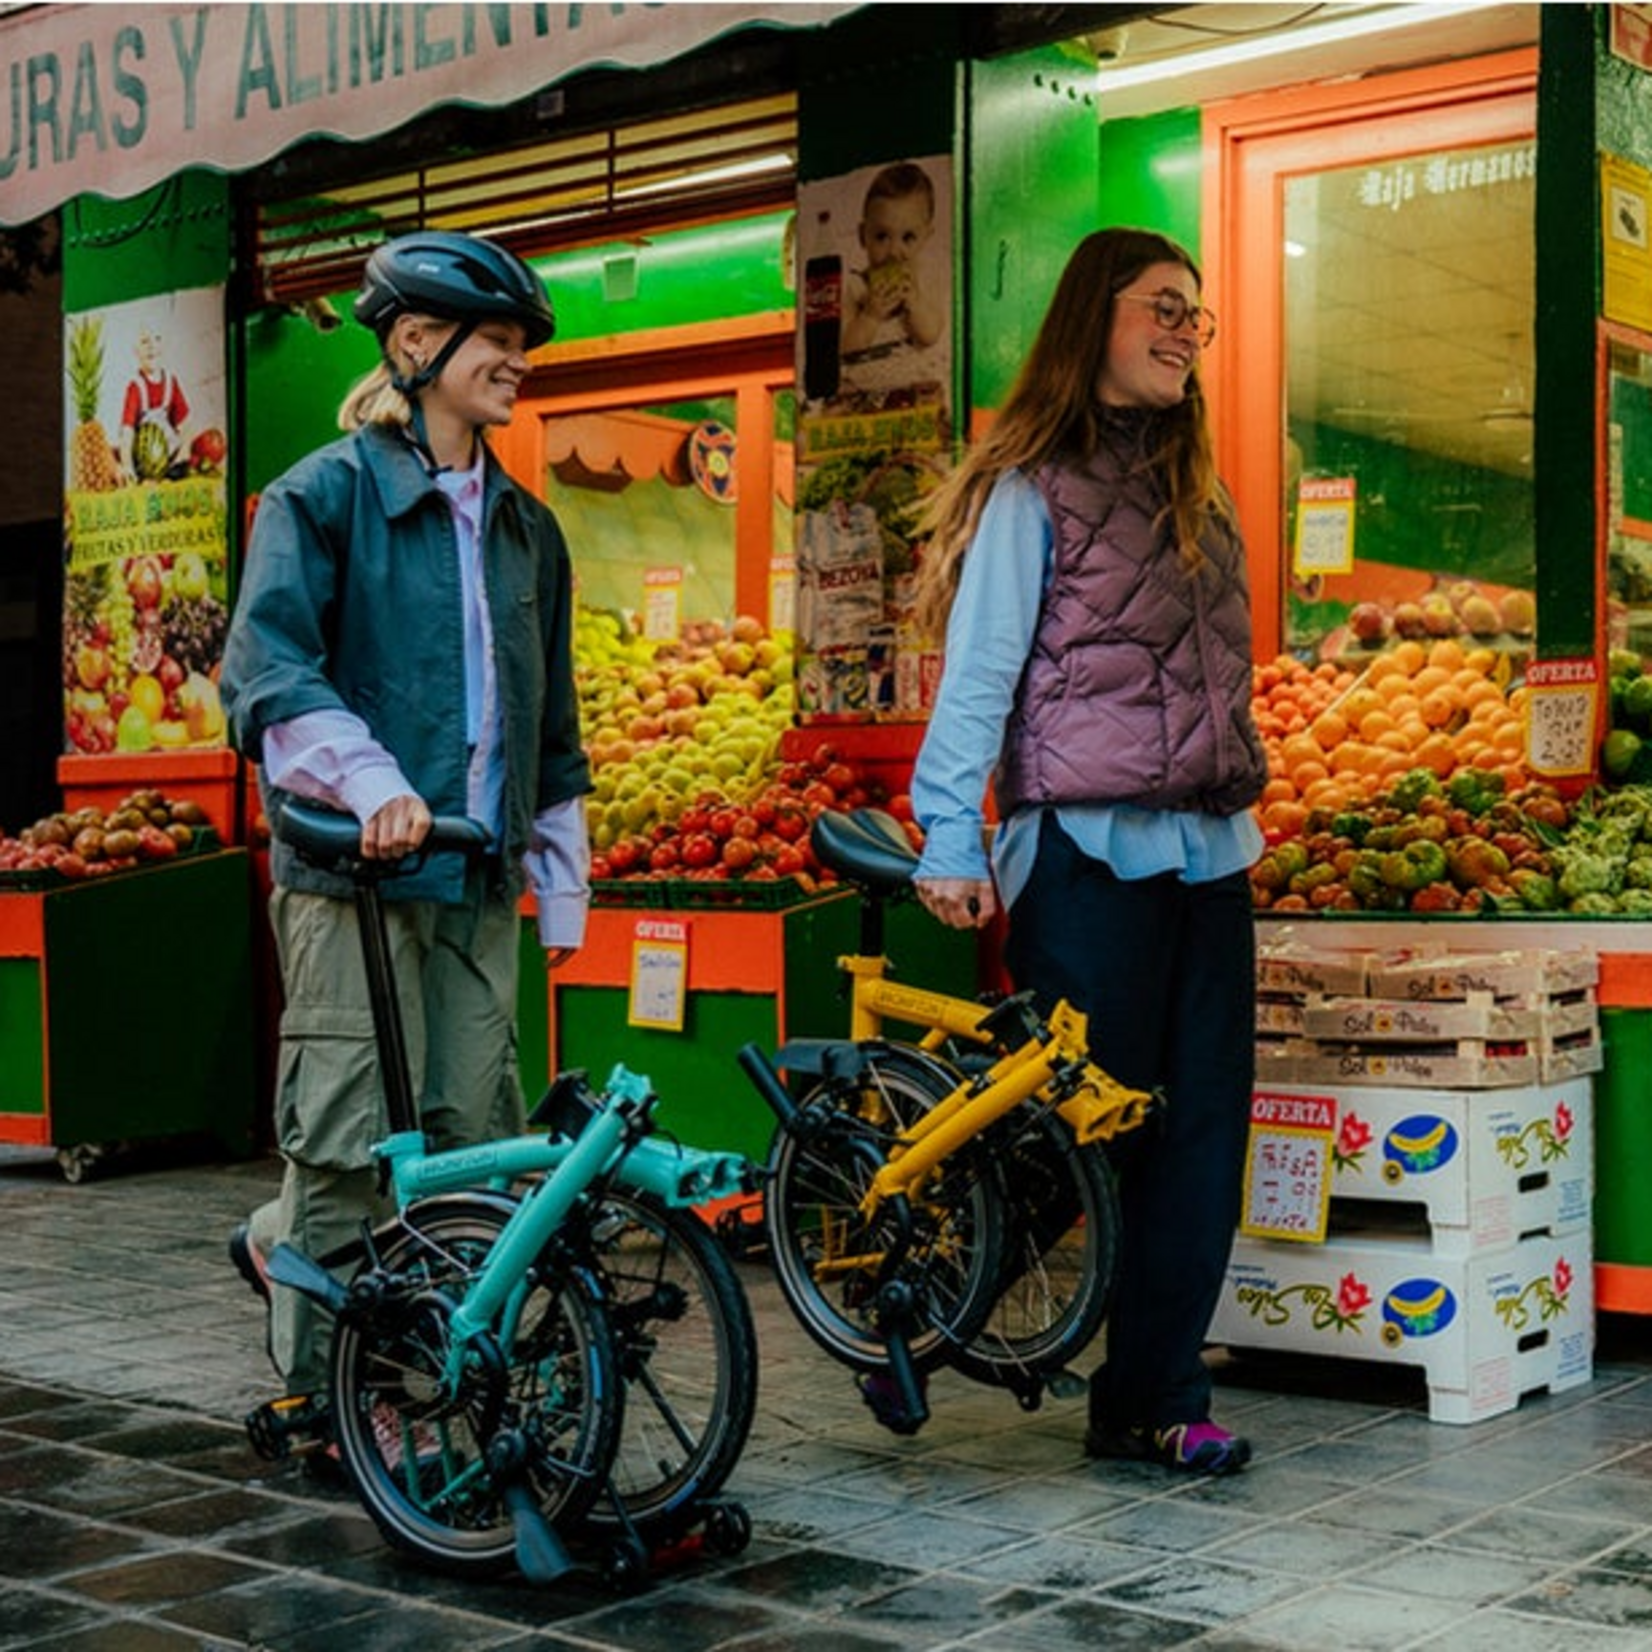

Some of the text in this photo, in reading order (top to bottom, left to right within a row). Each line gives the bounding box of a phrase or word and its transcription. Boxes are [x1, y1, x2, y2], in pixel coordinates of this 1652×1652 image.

[168, 6, 209, 130] Y
[234, 3, 667, 120] ALIME
[1529, 663, 1596, 683] OFERTA
[1407, 975, 1435, 1000] Sol
[1343, 1011, 1374, 1034] Sol
[1339, 1056, 1368, 1077] Sol
[1253, 1098, 1331, 1125] OFERTA
